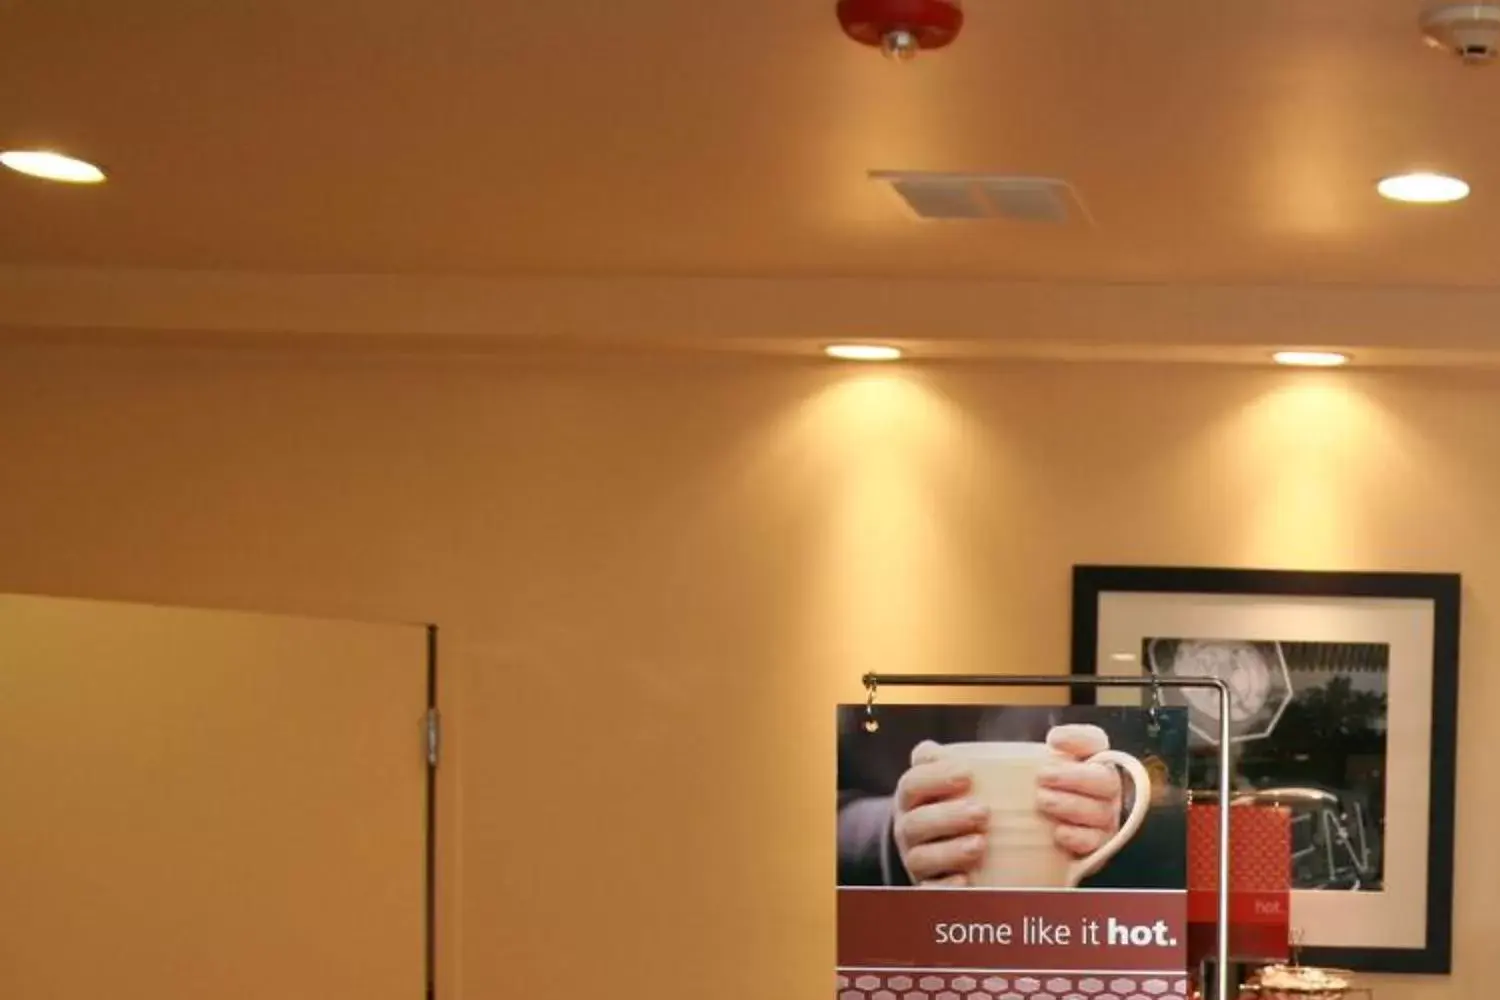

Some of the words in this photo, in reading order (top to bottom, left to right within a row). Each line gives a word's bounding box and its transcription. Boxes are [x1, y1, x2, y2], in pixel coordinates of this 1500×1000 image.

[935, 923, 1012, 945] some
[1023, 916, 1071, 945] like
[1082, 917, 1101, 945] it
[1107, 917, 1177, 946] hot.
